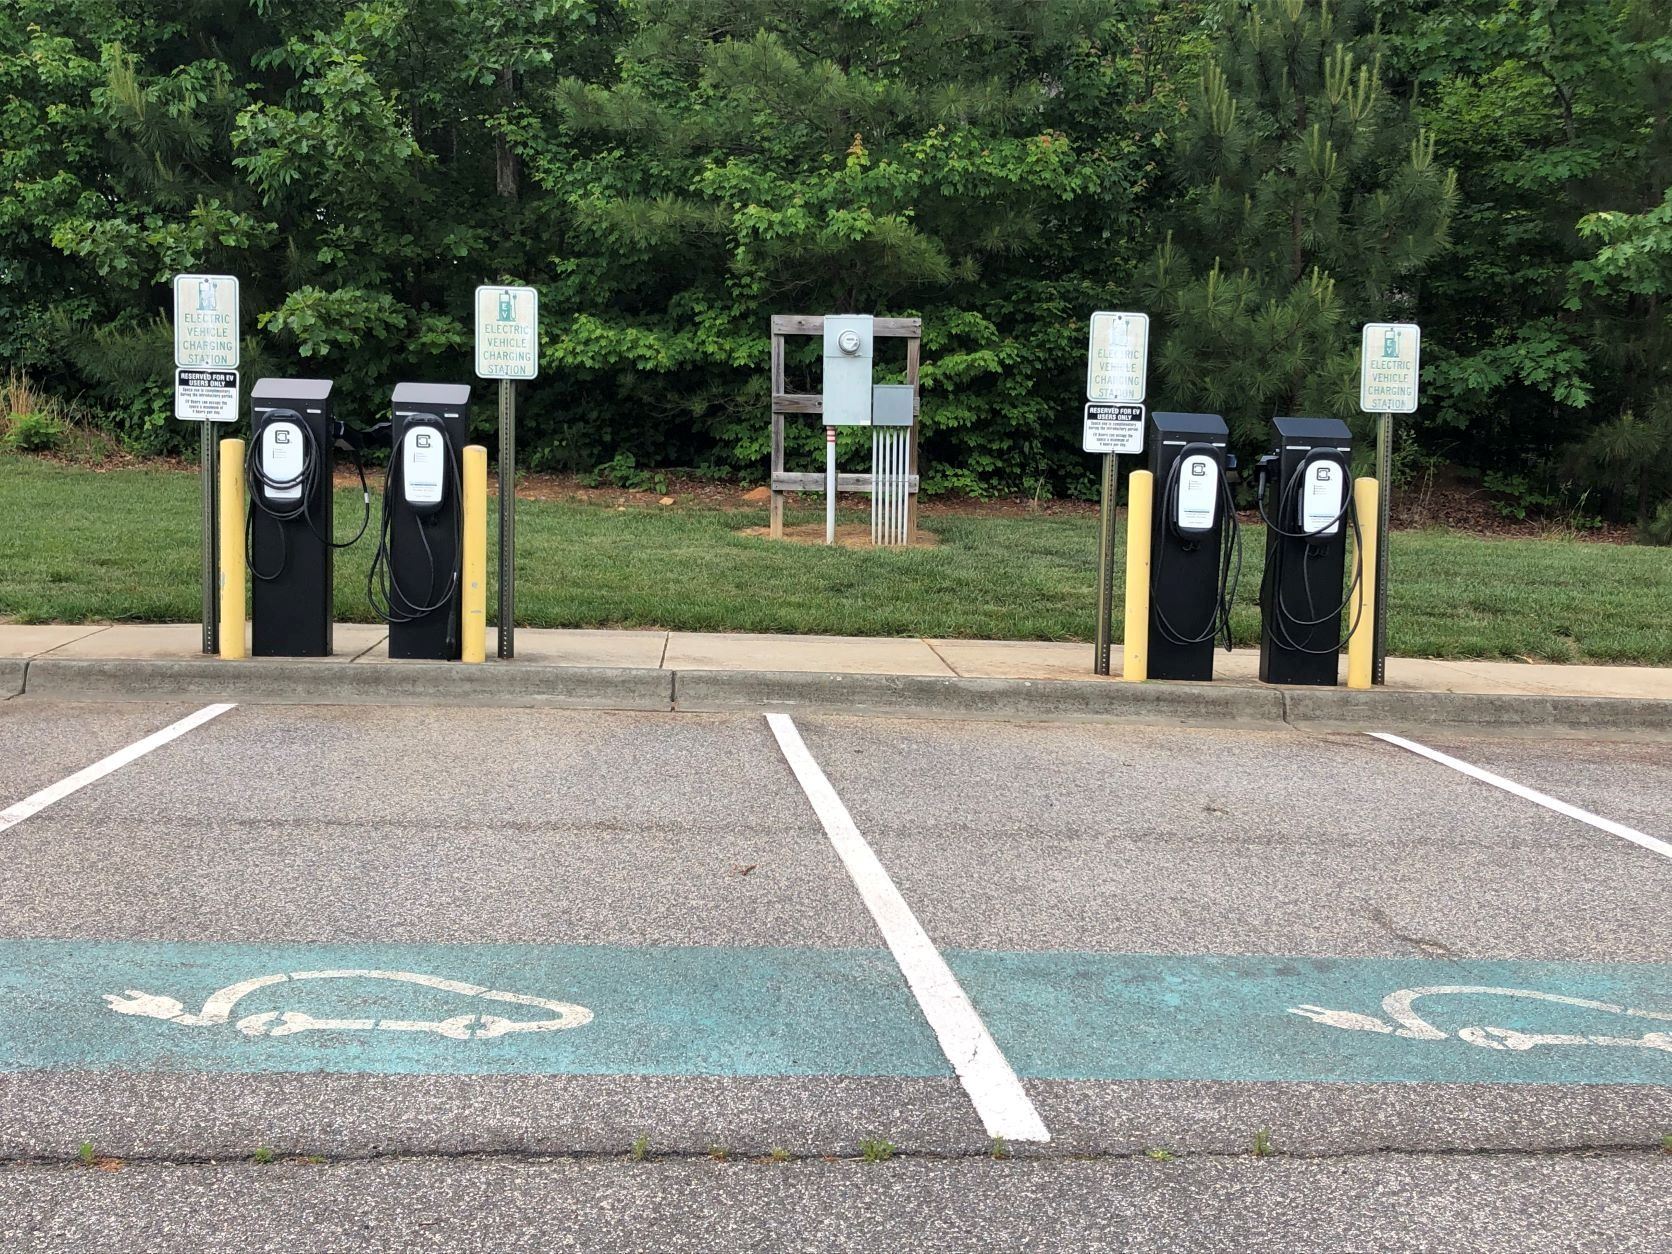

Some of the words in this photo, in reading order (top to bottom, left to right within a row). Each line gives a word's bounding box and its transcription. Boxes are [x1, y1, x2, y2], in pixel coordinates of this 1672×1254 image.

[184, 314, 230, 324] ELECTRIC
[187, 327, 228, 337] VEHICLE
[485, 324, 529, 335] ELECTRIC
[183, 341, 232, 351] CHARGING
[488, 338, 527, 348] VEHICLE
[188, 354, 227, 364] STATION
[483, 351, 531, 362] CHARGING
[1098, 349, 1139, 359] ELERIC
[488, 365, 526, 374] STATION
[1100, 362, 1136, 372] VEHLE
[1371, 360, 1410, 369] ELECTRIC
[1372, 373, 1408, 382] VEHICLE
[1368, 386, 1412, 396] CHARGING
[1372, 399, 1406, 408] STATION
